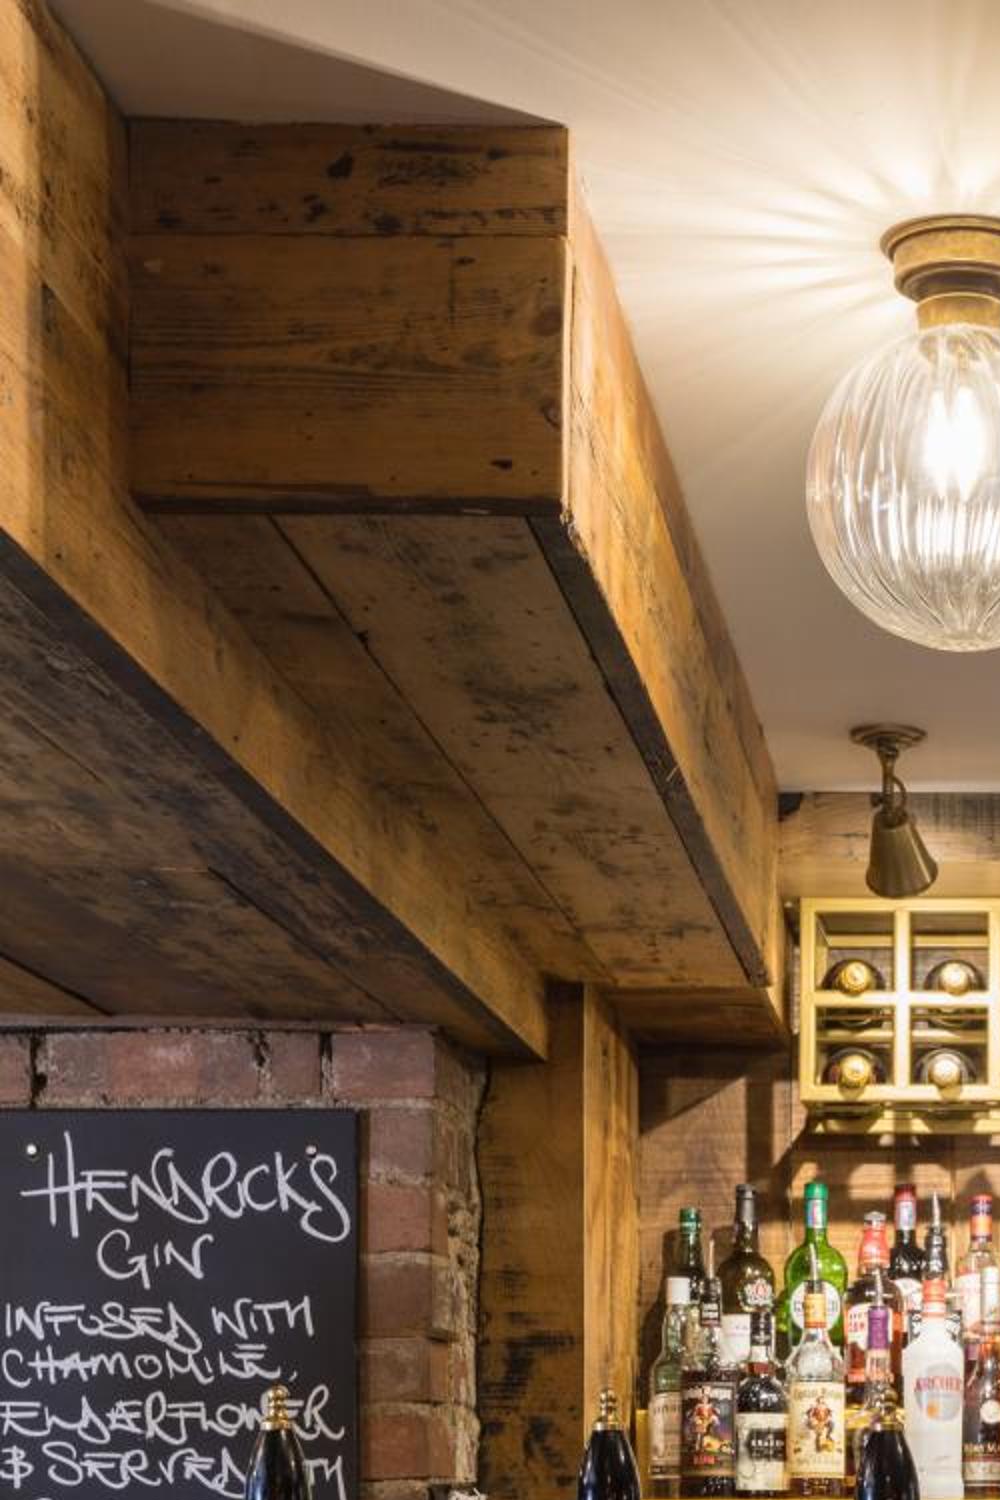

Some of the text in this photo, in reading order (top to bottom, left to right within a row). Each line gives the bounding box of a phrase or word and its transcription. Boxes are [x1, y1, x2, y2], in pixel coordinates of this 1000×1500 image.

[97, 1229, 213, 1289] GIN
[5, 1296, 314, 1354] INFUSED WITH
